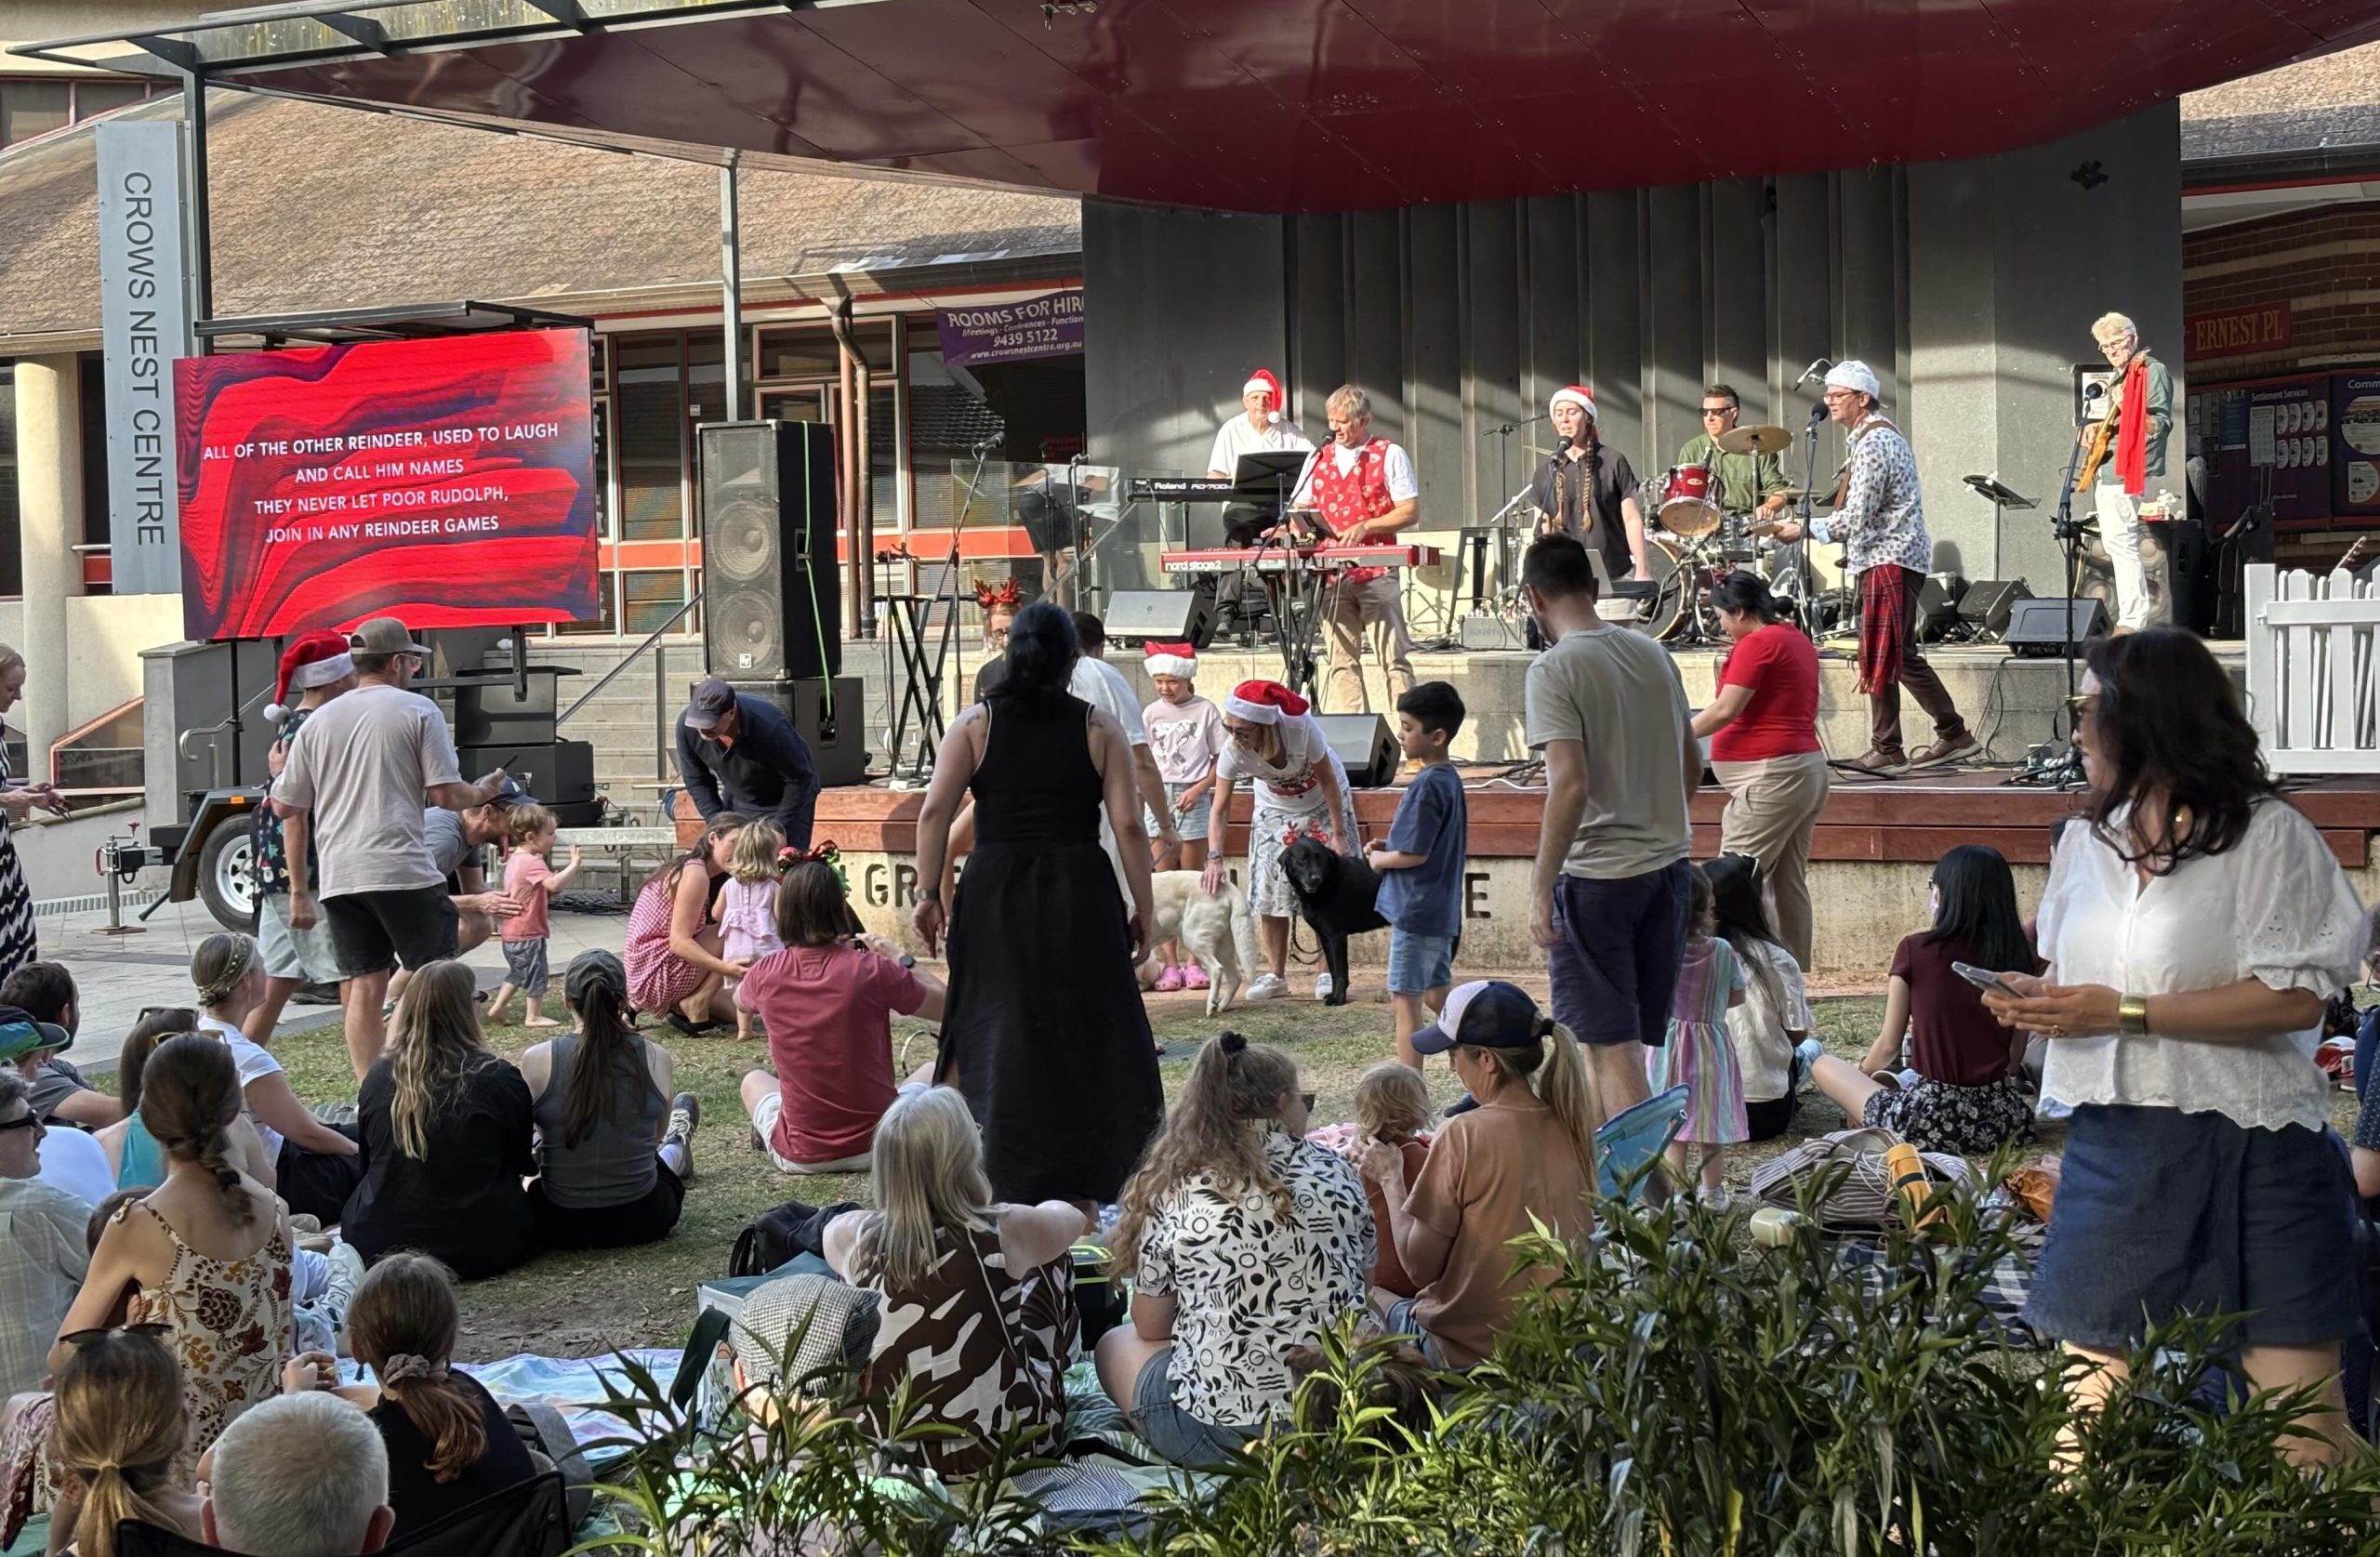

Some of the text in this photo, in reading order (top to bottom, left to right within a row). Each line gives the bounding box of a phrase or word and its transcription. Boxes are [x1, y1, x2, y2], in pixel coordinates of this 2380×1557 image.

[947, 310, 1013, 327] ROOMS
[1014, 300, 1050, 320] FOR
[962, 326, 998, 337] Meetings
[993, 328, 1058, 347] 9439 5122
[2195, 310, 2283, 351] ERNEST PL
[124, 171, 165, 546] CROWS NEST CENTRE
[971, 341, 1083, 359] www.crowsnestcentre.org.au
[2251, 389, 2283, 402] Settlement
[2283, 389, 2308, 399] Services
[203, 422, 559, 460] ALL OF THE OTHER REINDEER, USED TO LAUGH
[295, 458, 464, 483] AND CALL HIM NAMES
[254, 485, 509, 515] THEY NEVER LET POOR RUDOLPH,
[266, 515, 499, 544] JOIN IN ANY REINDEER GAMES
[1165, 561, 1188, 572] nord
